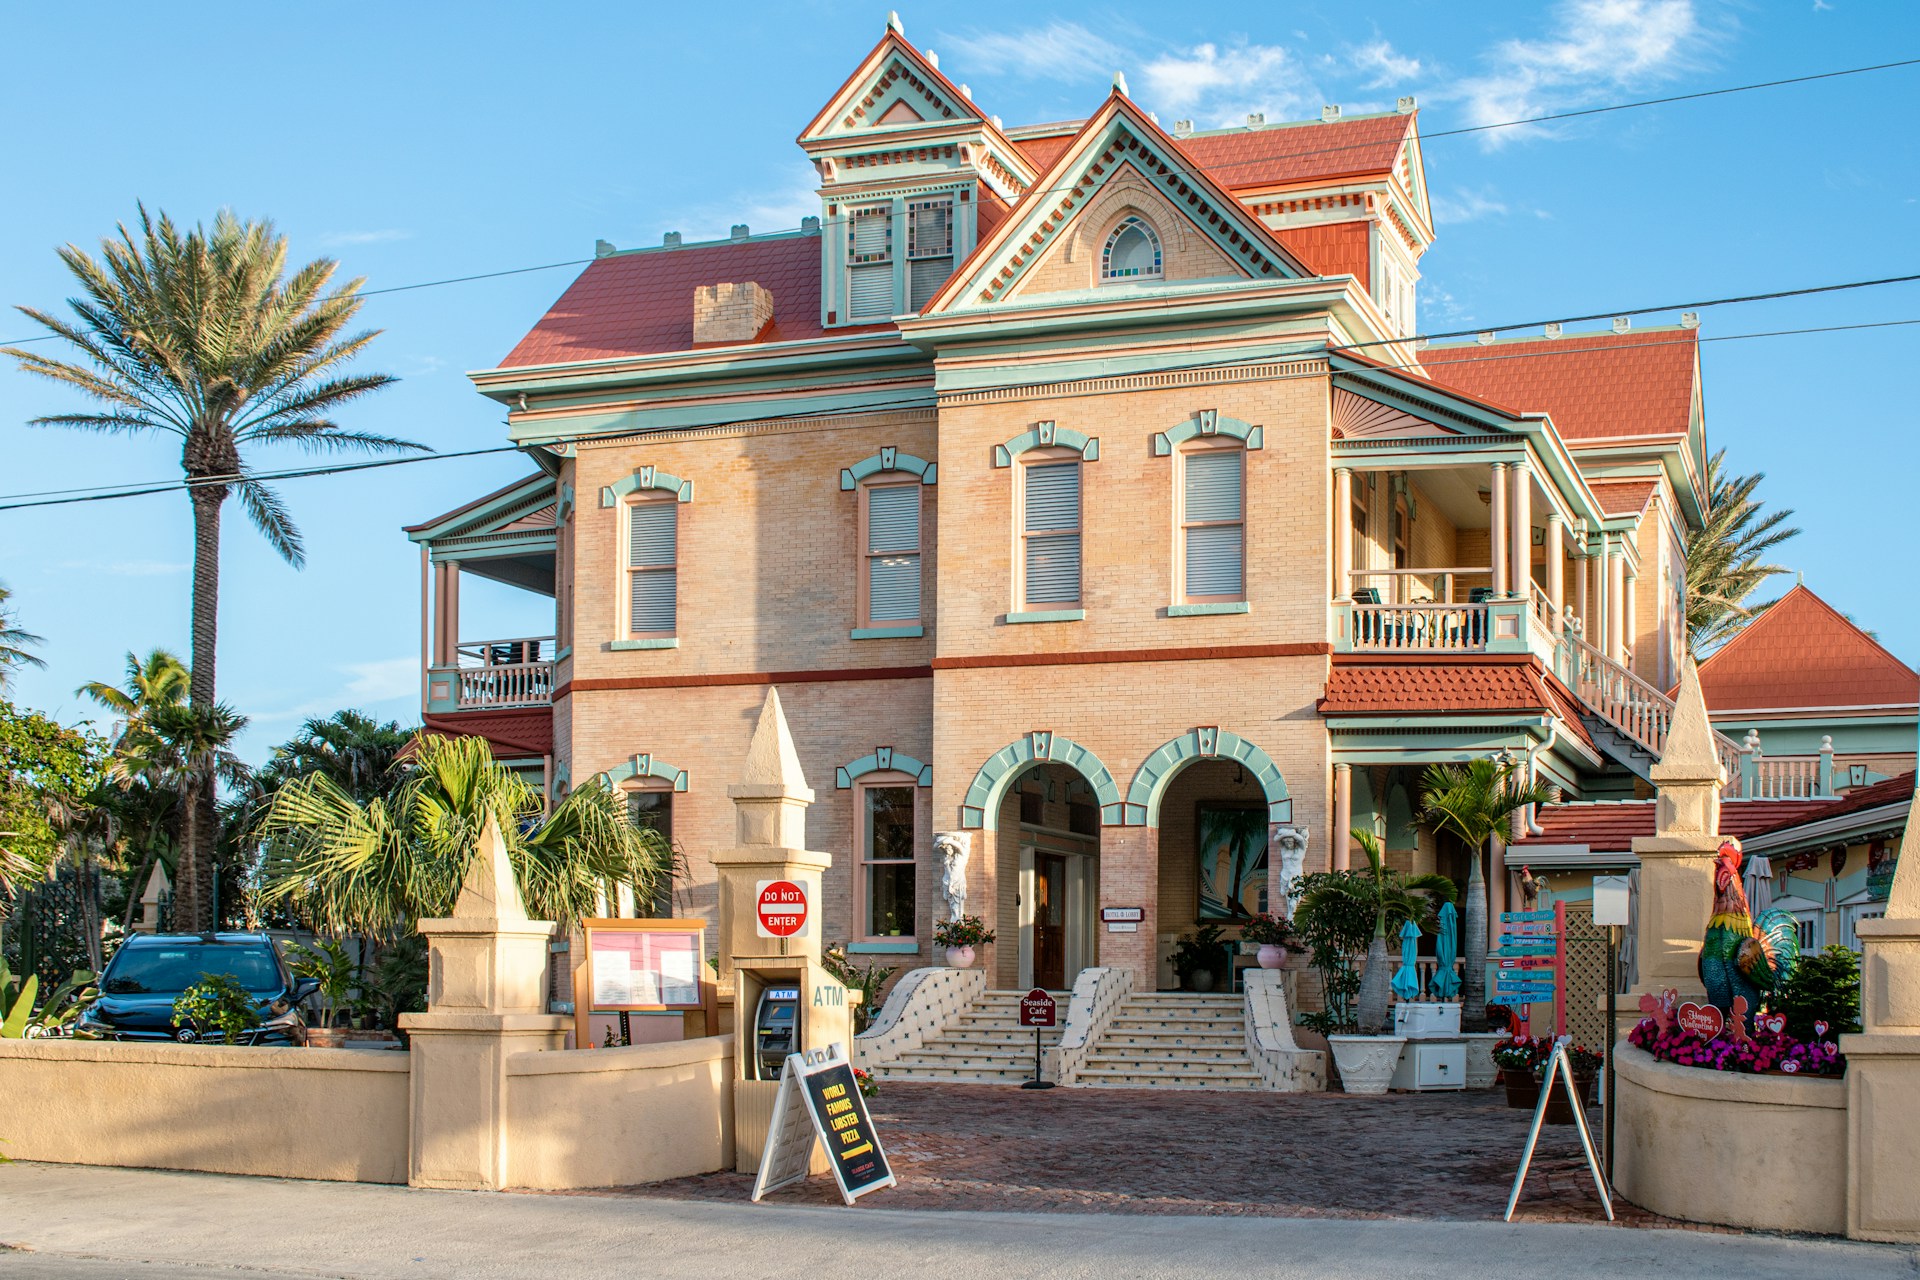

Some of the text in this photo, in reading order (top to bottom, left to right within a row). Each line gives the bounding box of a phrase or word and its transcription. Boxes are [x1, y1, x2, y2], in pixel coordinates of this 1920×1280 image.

[764, 892, 800, 901] DO NOT
[768, 917, 797, 926] ENTER
[813, 986, 843, 1006] ATM
[1023, 998, 1053, 1007] Seaside
[1520, 994, 1537, 1002] YORK
[1029, 1006, 1047, 1015] Cafe
[1687, 1010, 1712, 1024] Happy
[822, 1083, 846, 1100] WORLD
[825, 1097, 853, 1116] FAMOUS
[830, 1111, 859, 1132] LOBSTER
[840, 1128, 860, 1145] PIZZA
